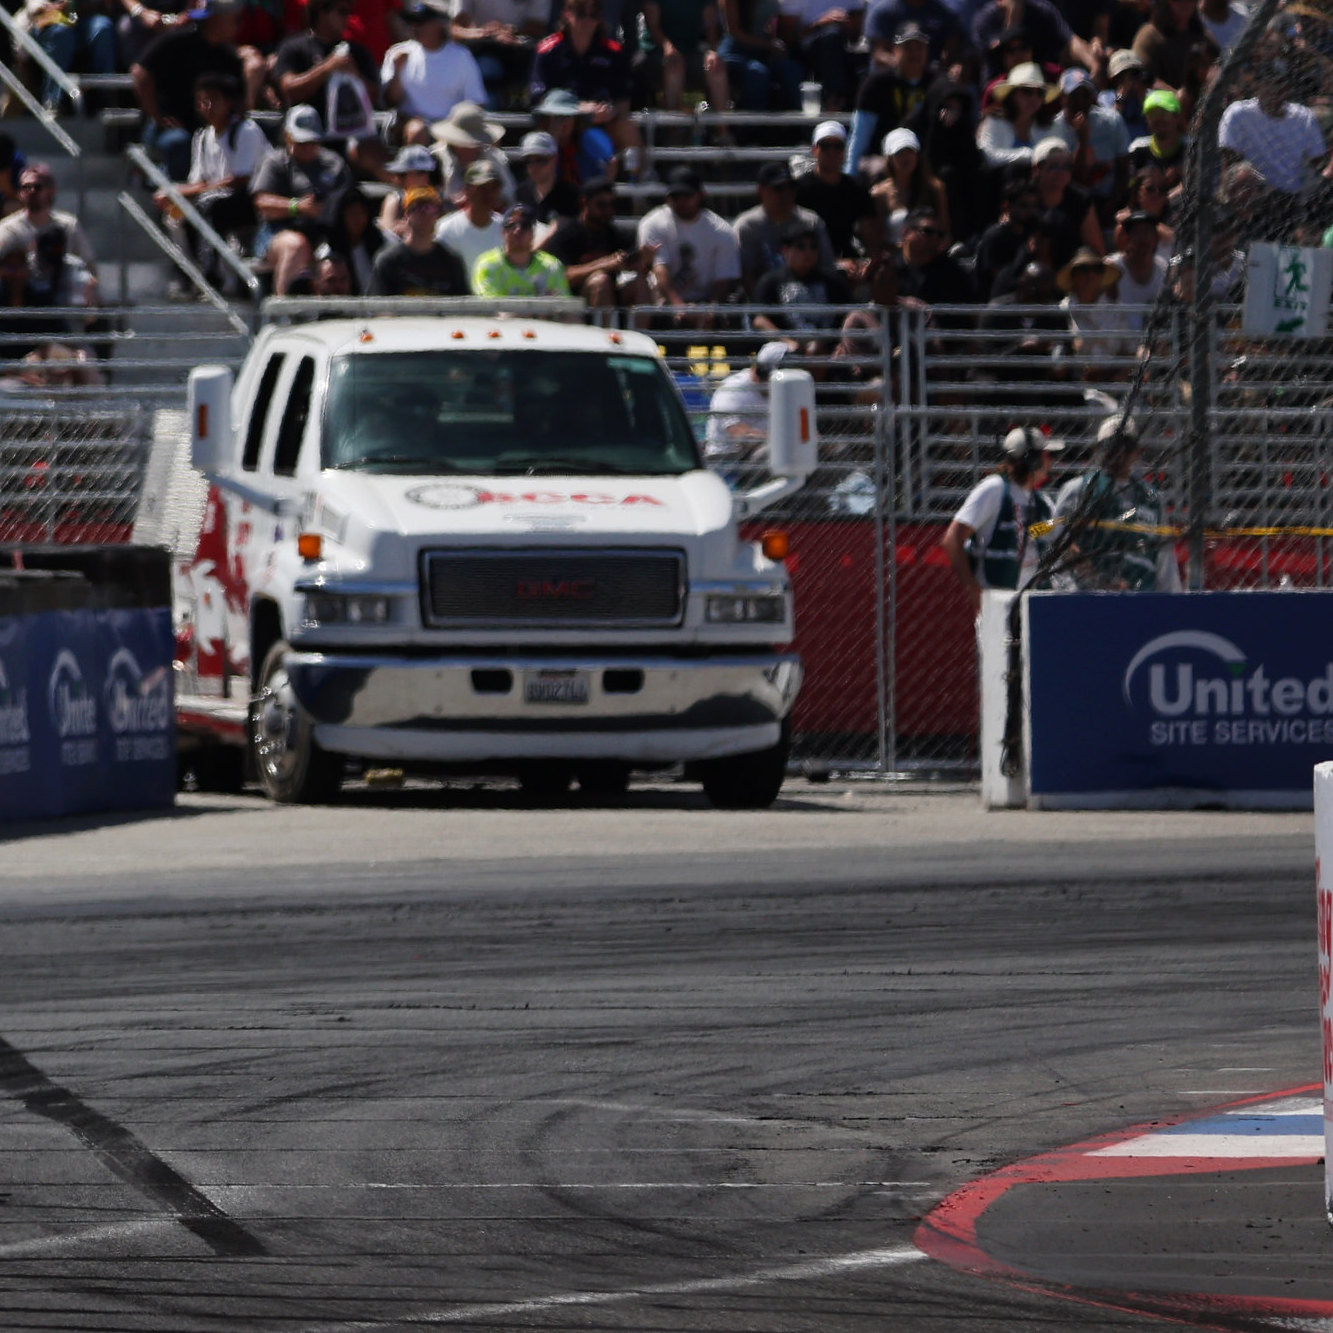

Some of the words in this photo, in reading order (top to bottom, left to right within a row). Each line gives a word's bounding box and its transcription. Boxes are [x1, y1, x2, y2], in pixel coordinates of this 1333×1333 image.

[517, 580, 595, 598] GMC
[1149, 662, 1333, 716] United
[1149, 720, 1207, 745] SITE
